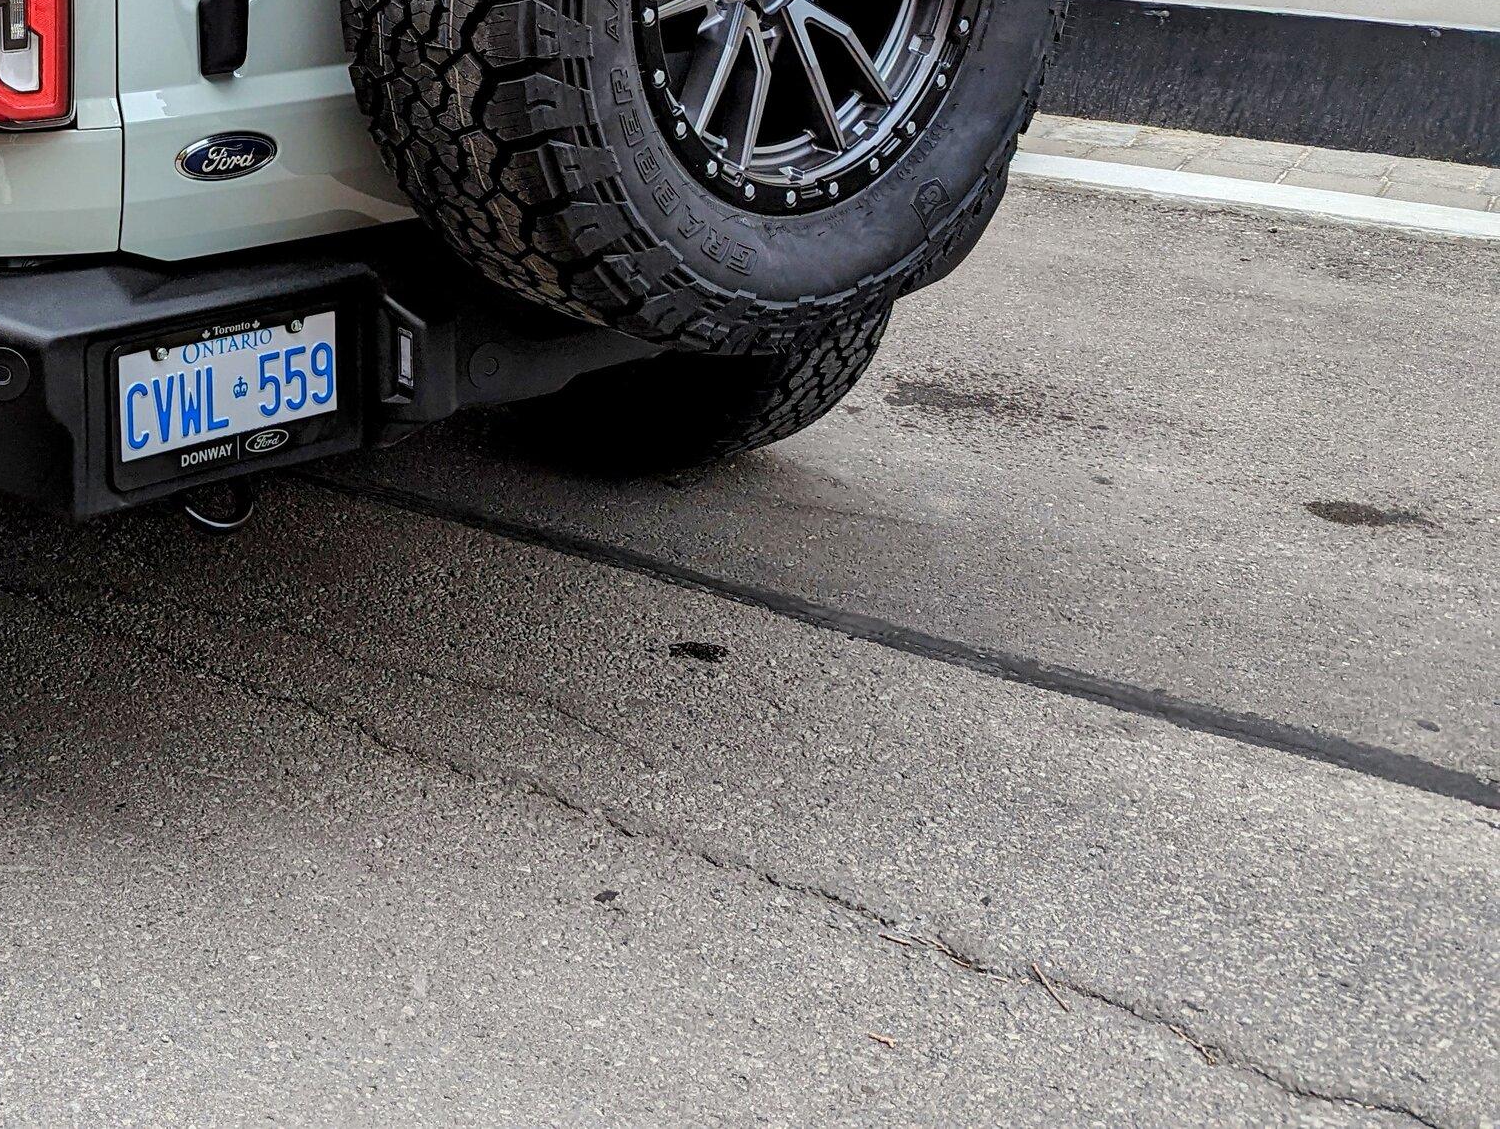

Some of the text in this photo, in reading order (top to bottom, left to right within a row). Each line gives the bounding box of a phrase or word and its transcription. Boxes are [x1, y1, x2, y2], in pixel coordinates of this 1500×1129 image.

[610, 67, 758, 275] GRABBER
[182, 328, 272, 364] ONTARIO
[213, 320, 250, 336] Toronto
[125, 342, 333, 450] CVWL 559
[181, 443, 233, 468] DONWAY
